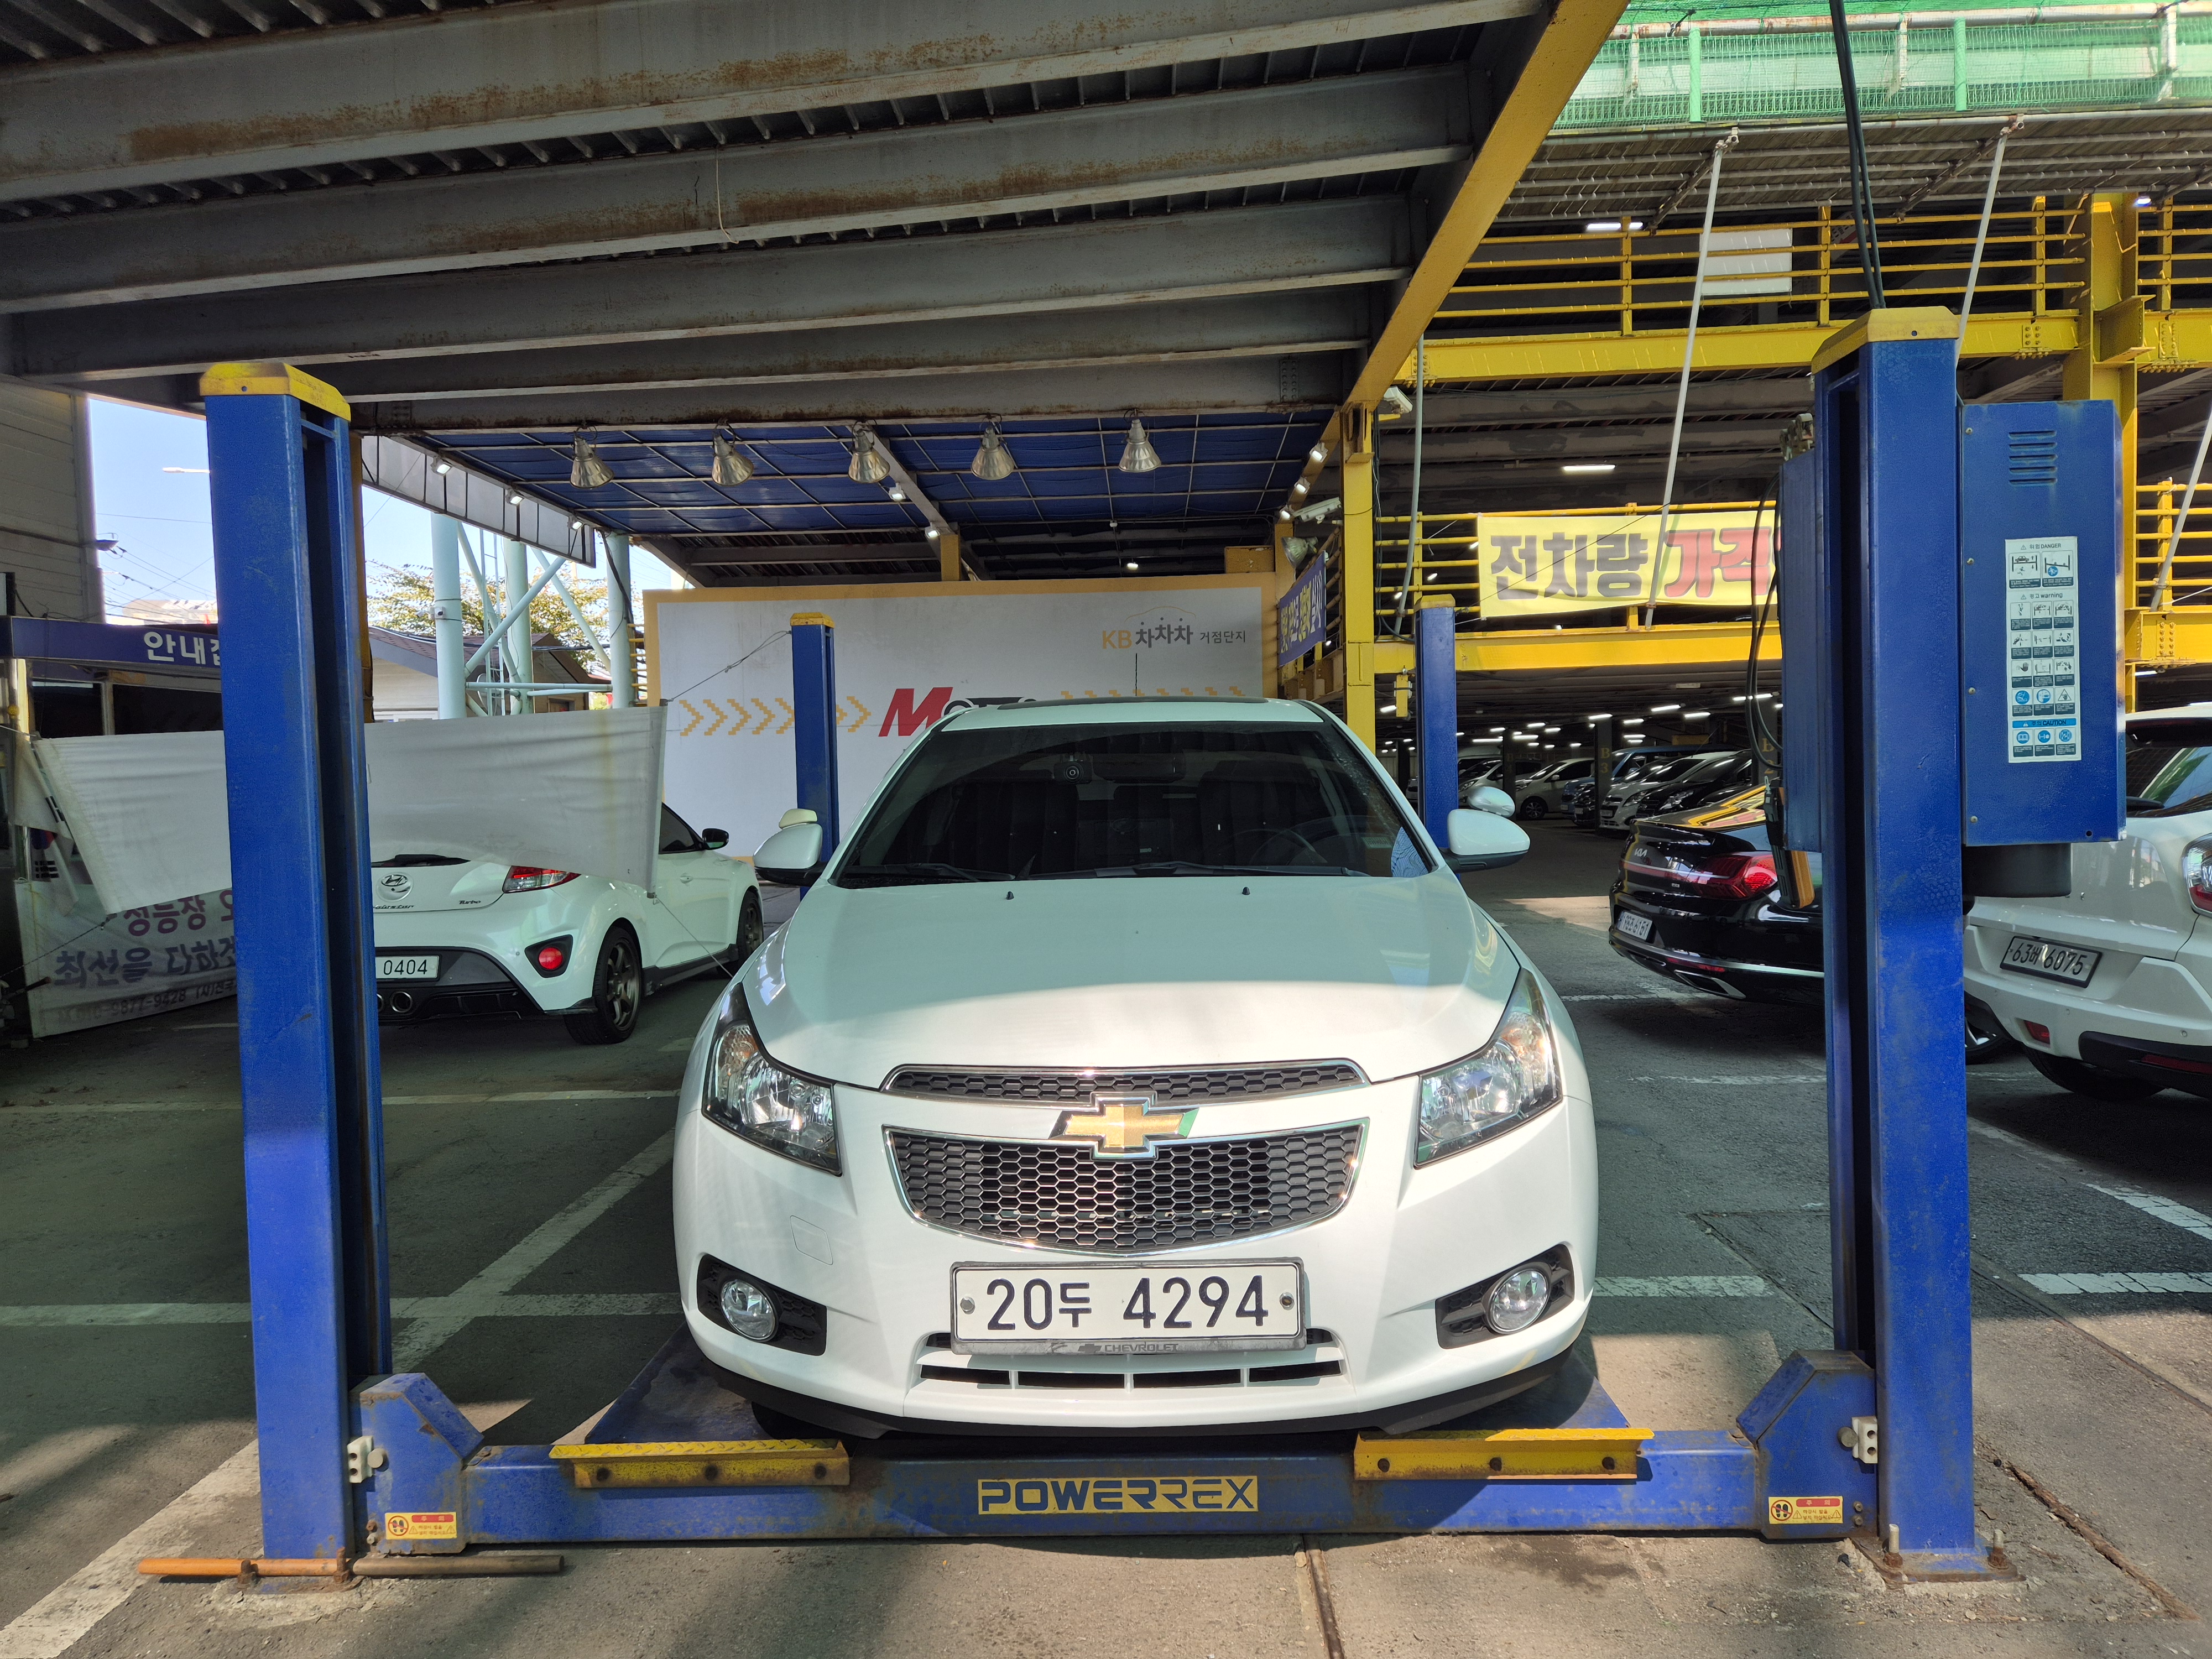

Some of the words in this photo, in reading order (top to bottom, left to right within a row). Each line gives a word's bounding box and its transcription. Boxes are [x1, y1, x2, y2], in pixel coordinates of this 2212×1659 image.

[1490, 532, 1648, 599] 전차량
[1665, 527, 1780, 597] 가격
[1200, 630, 1246, 644] 거점단지
[1600, 748, 1610, 758] B
[1600, 763, 1609, 774] 3
[54, 947, 153, 989] 최선을
[383, 959, 428, 975] 0404
[2043, 948, 2088, 975] 6075
[987, 1277, 1092, 1331] 20두
[1123, 1275, 1269, 1329] 4294
[1104, 1342, 1179, 1353] CHEVROLET
[982, 1478, 1254, 1512] POWERREX
